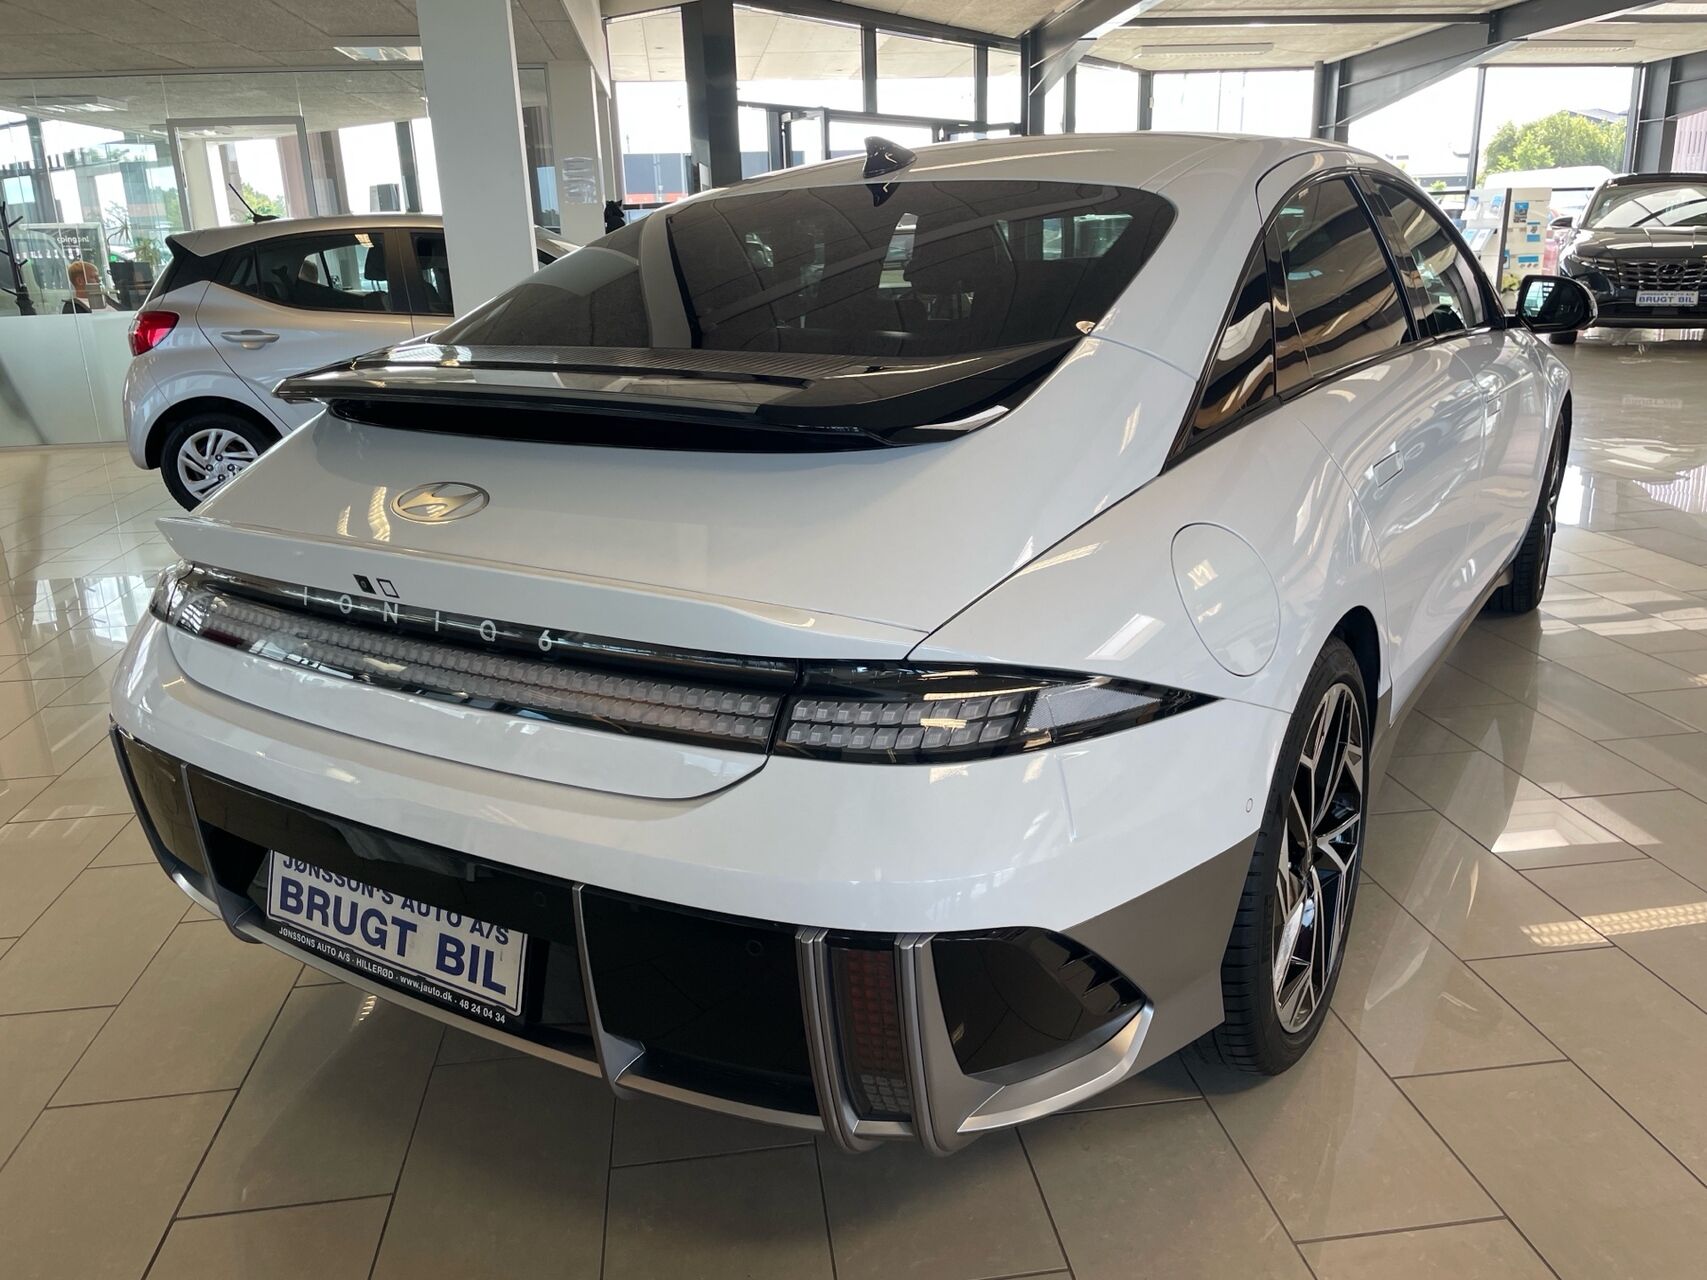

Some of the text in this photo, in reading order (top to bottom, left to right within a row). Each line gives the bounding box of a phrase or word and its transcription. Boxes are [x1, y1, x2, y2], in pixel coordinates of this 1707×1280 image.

[303, 586, 551, 651] IONIQ 6
[279, 875, 507, 995] BRUGT BIL
[470, 919, 509, 945] A/S
[279, 927, 506, 1023] JØNSSONS AUTO A/S HILLERØD www.jauto.dk 48 24 04 34
